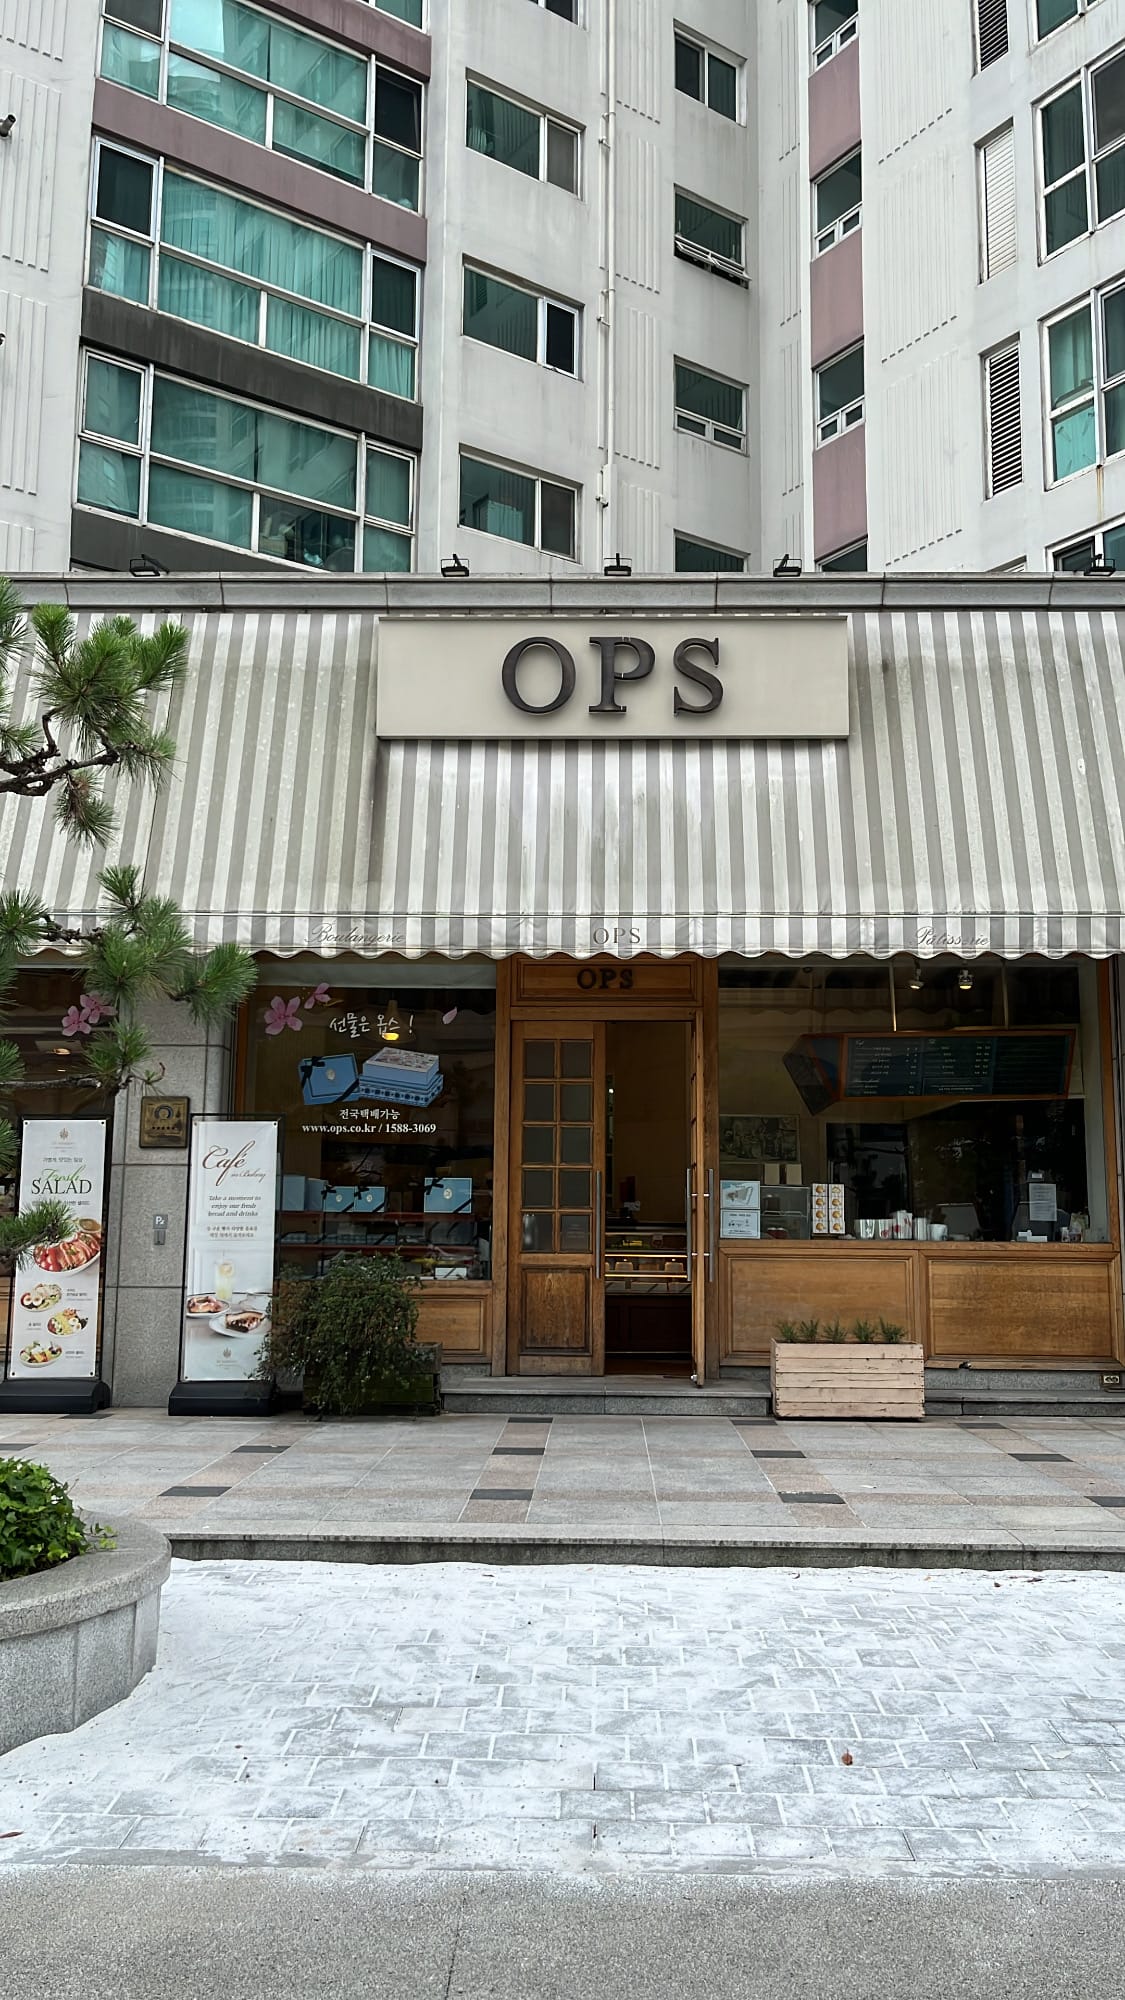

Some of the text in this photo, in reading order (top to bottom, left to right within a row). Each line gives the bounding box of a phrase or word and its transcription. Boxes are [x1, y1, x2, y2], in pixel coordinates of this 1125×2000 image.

[502, 636, 723, 714] OPS
[304, 922, 406, 947] Boulangerie
[593, 927, 641, 945] OPS
[576, 967, 634, 990] OPS
[329, 1012, 371, 1039] 선물은
[376, 1014, 401, 1038] 옵스
[339, 1108, 401, 1120] 전국택배가능
[302, 1123, 377, 1135] www.ops.co.kr
[385, 1123, 437, 1133] 1588-3069
[202, 1140, 256, 1187] Café
[31, 1178, 92, 1195] SALAD
